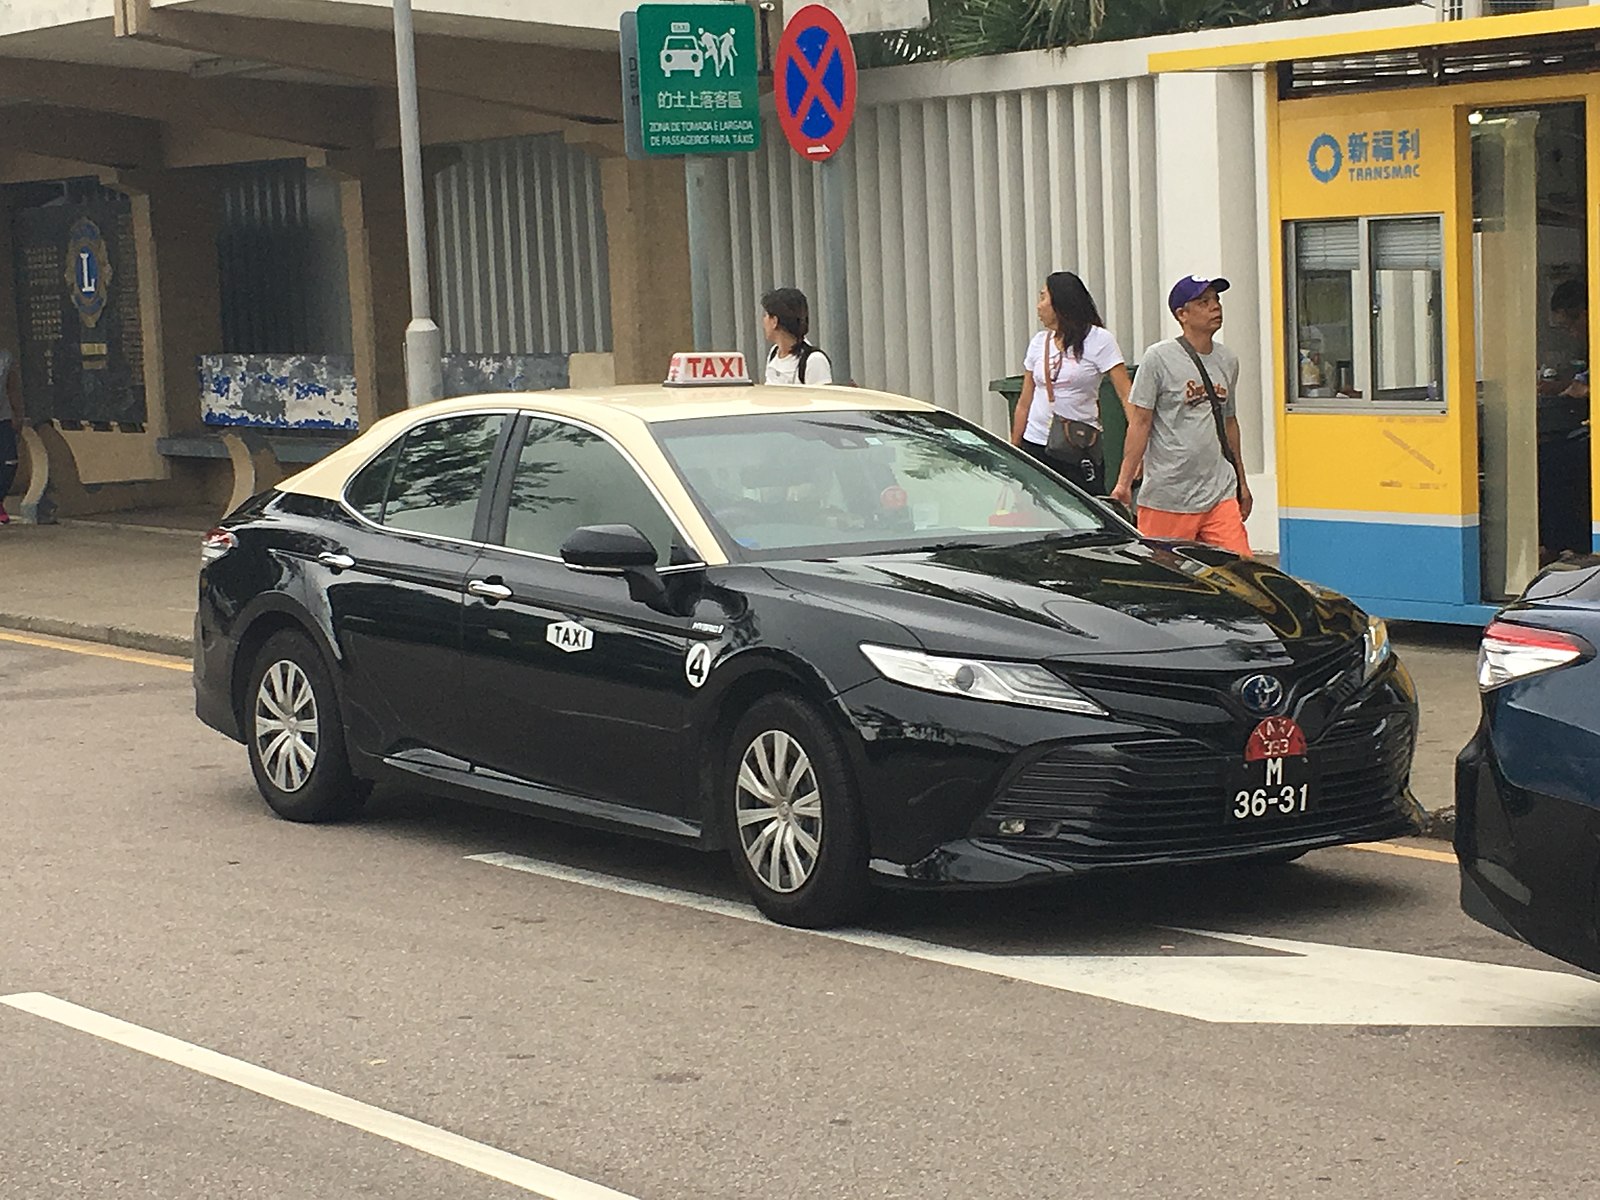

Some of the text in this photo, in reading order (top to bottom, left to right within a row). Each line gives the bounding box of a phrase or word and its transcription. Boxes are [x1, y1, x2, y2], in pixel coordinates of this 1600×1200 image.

[658, 91, 742, 108] 的士上落客區
[649, 120, 754, 132] ZONA DE TOMADA E LARGADA
[650, 132, 754, 146] DE PASSAGEIROS PARA TÁXIS
[1348, 128, 1420, 164] 新福利
[1348, 164, 1420, 182] TRANSMAC
[79, 252, 96, 293] L
[687, 356, 744, 378] TAXI
[554, 625, 588, 648] TAXI
[688, 648, 706, 684] 4
[1254, 718, 1296, 741] TAXI
[1265, 757, 1283, 786] M
[1233, 783, 1308, 819] 36-31
